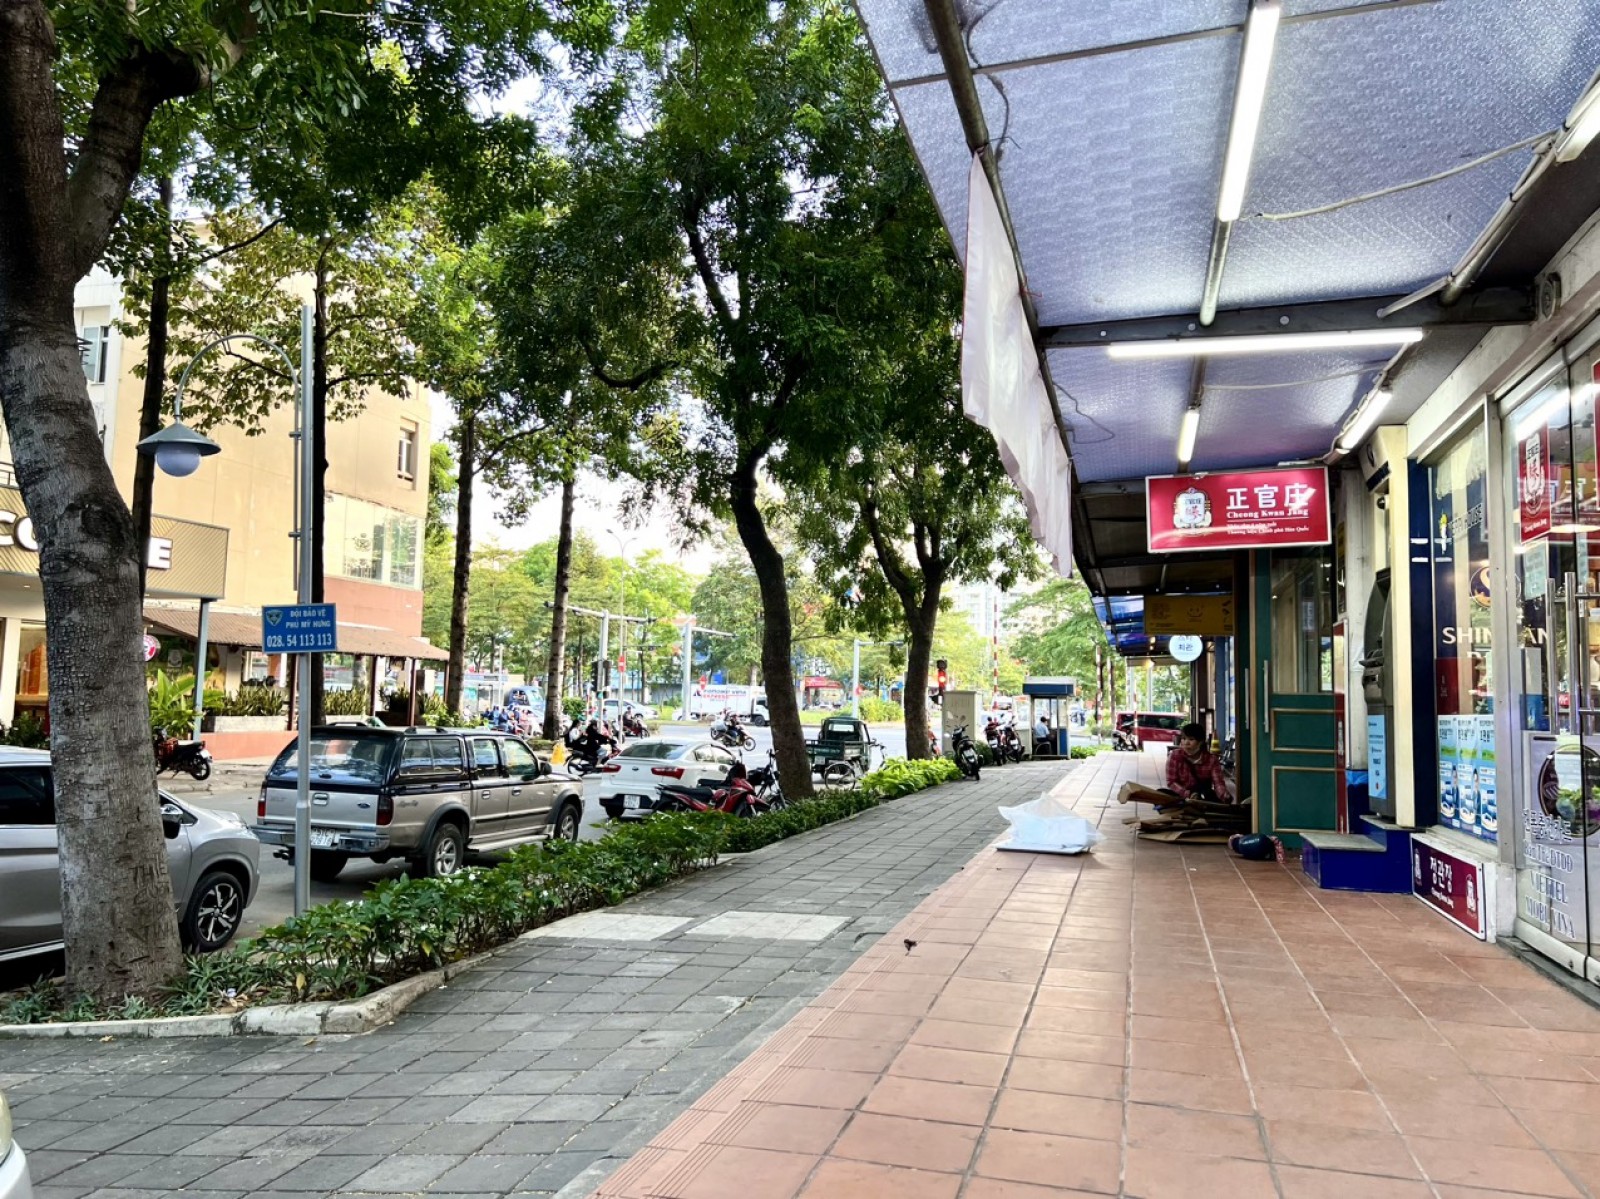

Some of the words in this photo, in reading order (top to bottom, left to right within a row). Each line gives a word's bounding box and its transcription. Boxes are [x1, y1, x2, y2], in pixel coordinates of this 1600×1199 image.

[1226, 511, 1259, 519] Cheong
[267, 636, 284, 647] 028.
[286, 635, 297, 647] 54
[300, 634, 315, 646] 113
[317, 633, 332, 646] 113
[1430, 856, 1453, 893] 정관장
